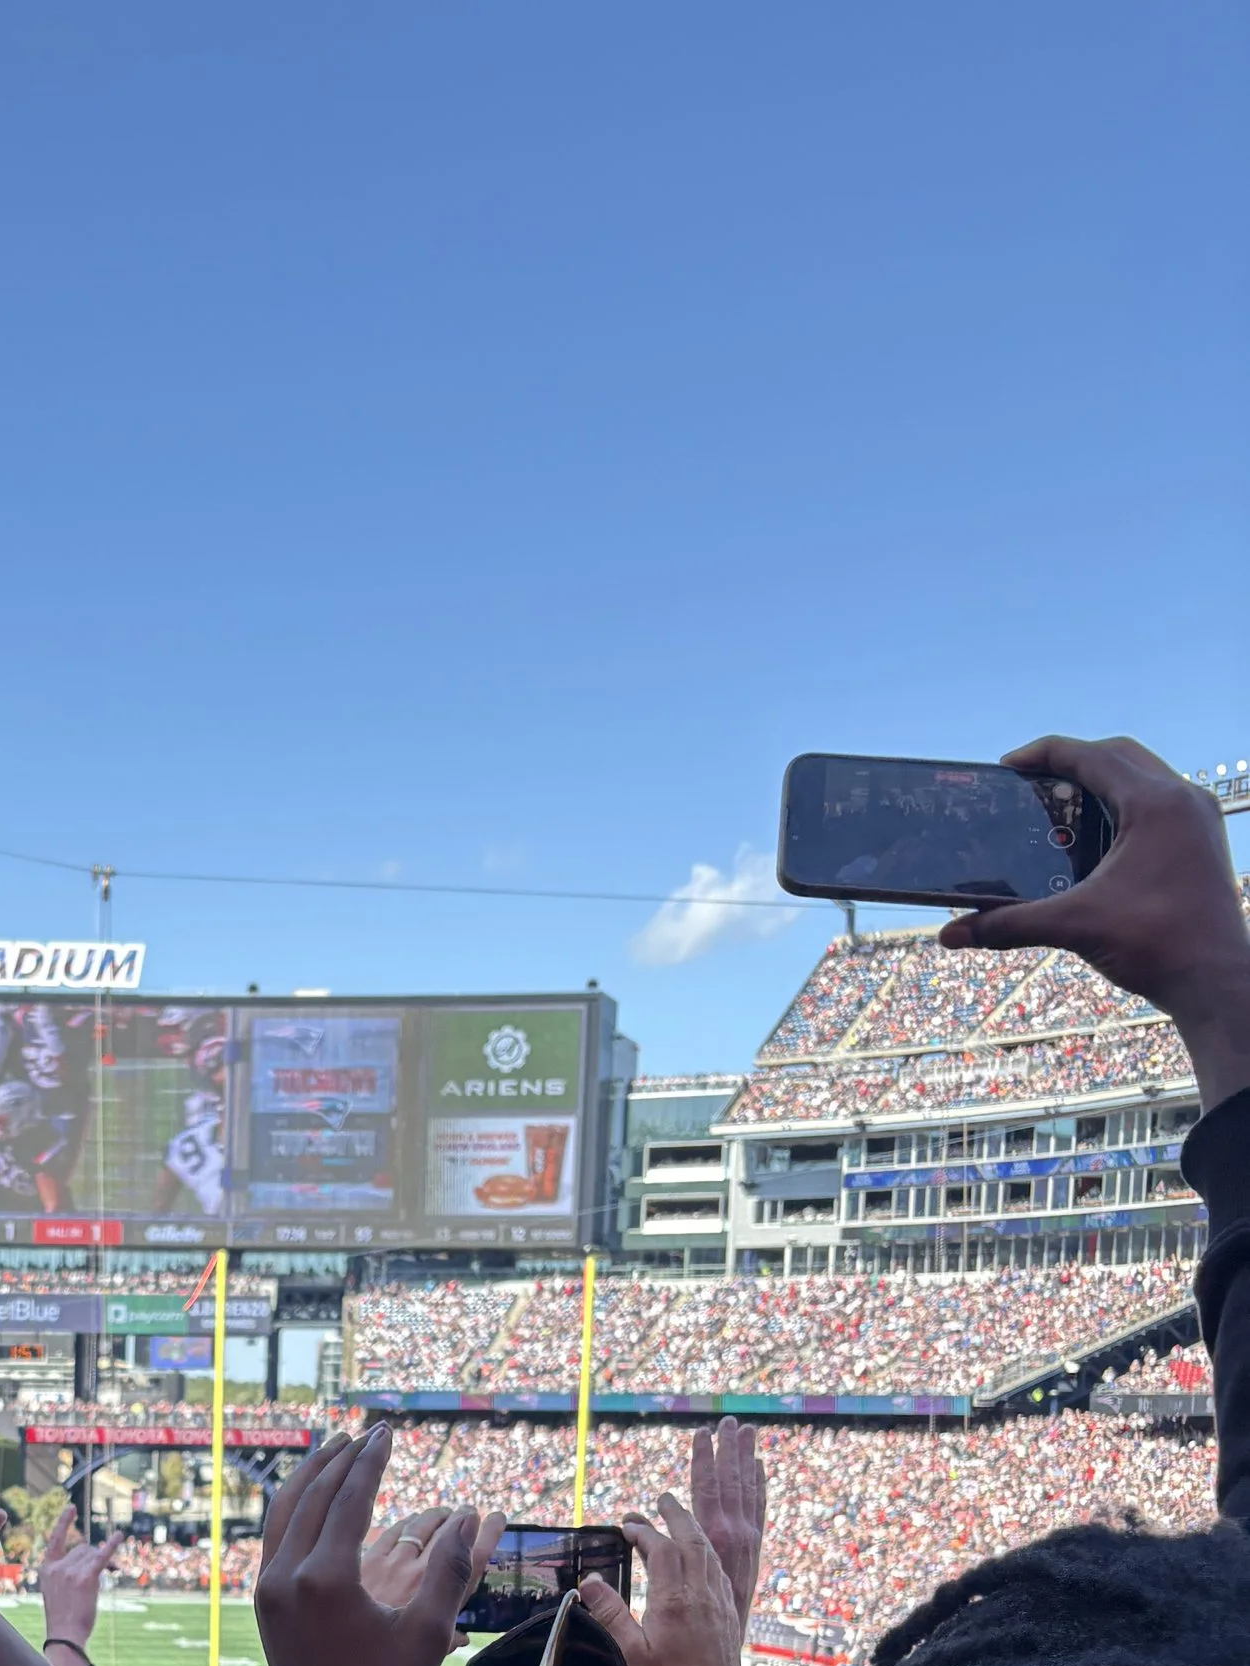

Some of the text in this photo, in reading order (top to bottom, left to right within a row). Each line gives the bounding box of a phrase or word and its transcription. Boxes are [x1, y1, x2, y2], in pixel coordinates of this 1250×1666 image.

[440, 1079, 566, 1097] ARIENS
[129, 1311, 184, 1324] paycom
[35, 1427, 95, 1443] TOYOTA
[105, 1428, 165, 1444] TOYOTA
[242, 1430, 301, 1446] TOYOTA
